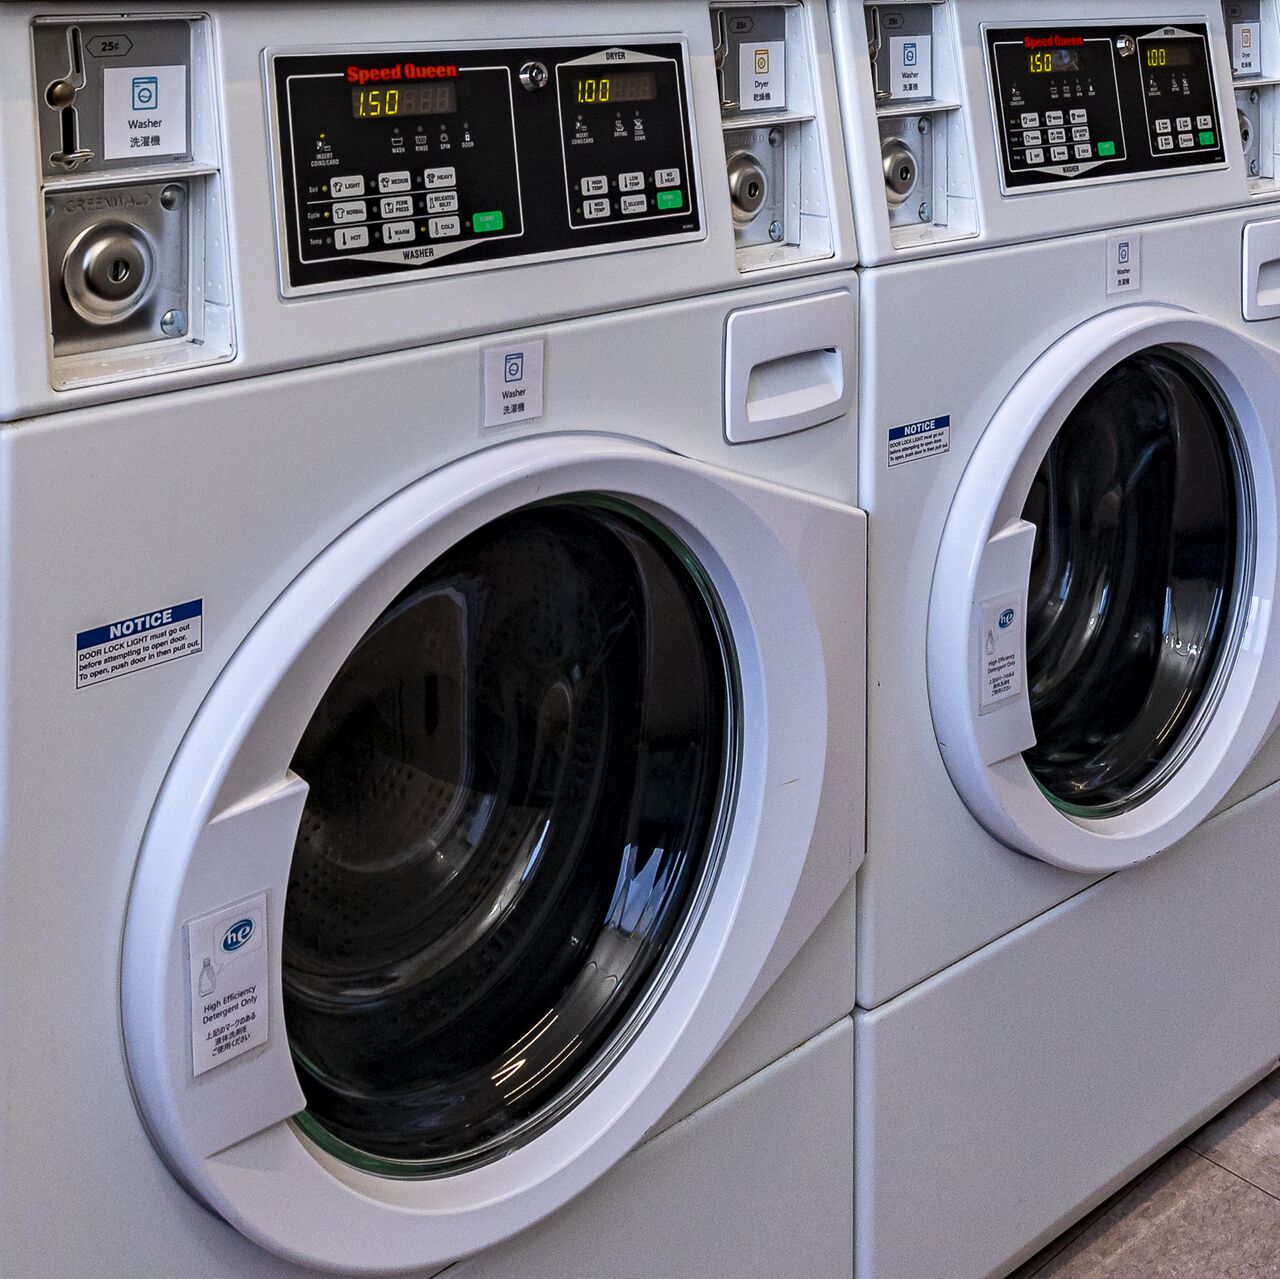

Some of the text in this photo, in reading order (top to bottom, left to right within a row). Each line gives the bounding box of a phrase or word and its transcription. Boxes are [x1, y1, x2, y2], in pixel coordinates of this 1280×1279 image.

[1024, 36, 1053, 49] Speed
[606, 52, 625, 60] DRYER
[347, 64, 457, 84] Speed Queen
[755, 80, 769, 88] Dryer
[578, 79, 610, 103] 1.00
[359, 90, 399, 117] 1.50
[128, 118, 162, 129] Washer
[130, 135, 160, 148] 洗濯機
[403, 248, 434, 260] WASHER
[502, 389, 526, 399] Washer
[905, 420, 935, 435] NOTICE
[110, 609, 172, 639] NOTICE
[80, 623, 190, 662] DOOR LOCK LIGHT must go out
[80, 660, 102, 671] before
[104, 648, 140, 665] attempting
[152, 640, 168, 650] open
[170, 634, 187, 644] door.
[80, 673, 88, 681] To
[90, 668, 110, 678] open,
[111, 661, 128, 672] push
[130, 656, 146, 665] door
[157, 648, 171, 658] then
[173, 643, 185, 654] pull
[187, 640, 200, 649] out.
[204, 984, 257, 1013] High Efficiency
[202, 995, 258, 1025] Detergent Only
